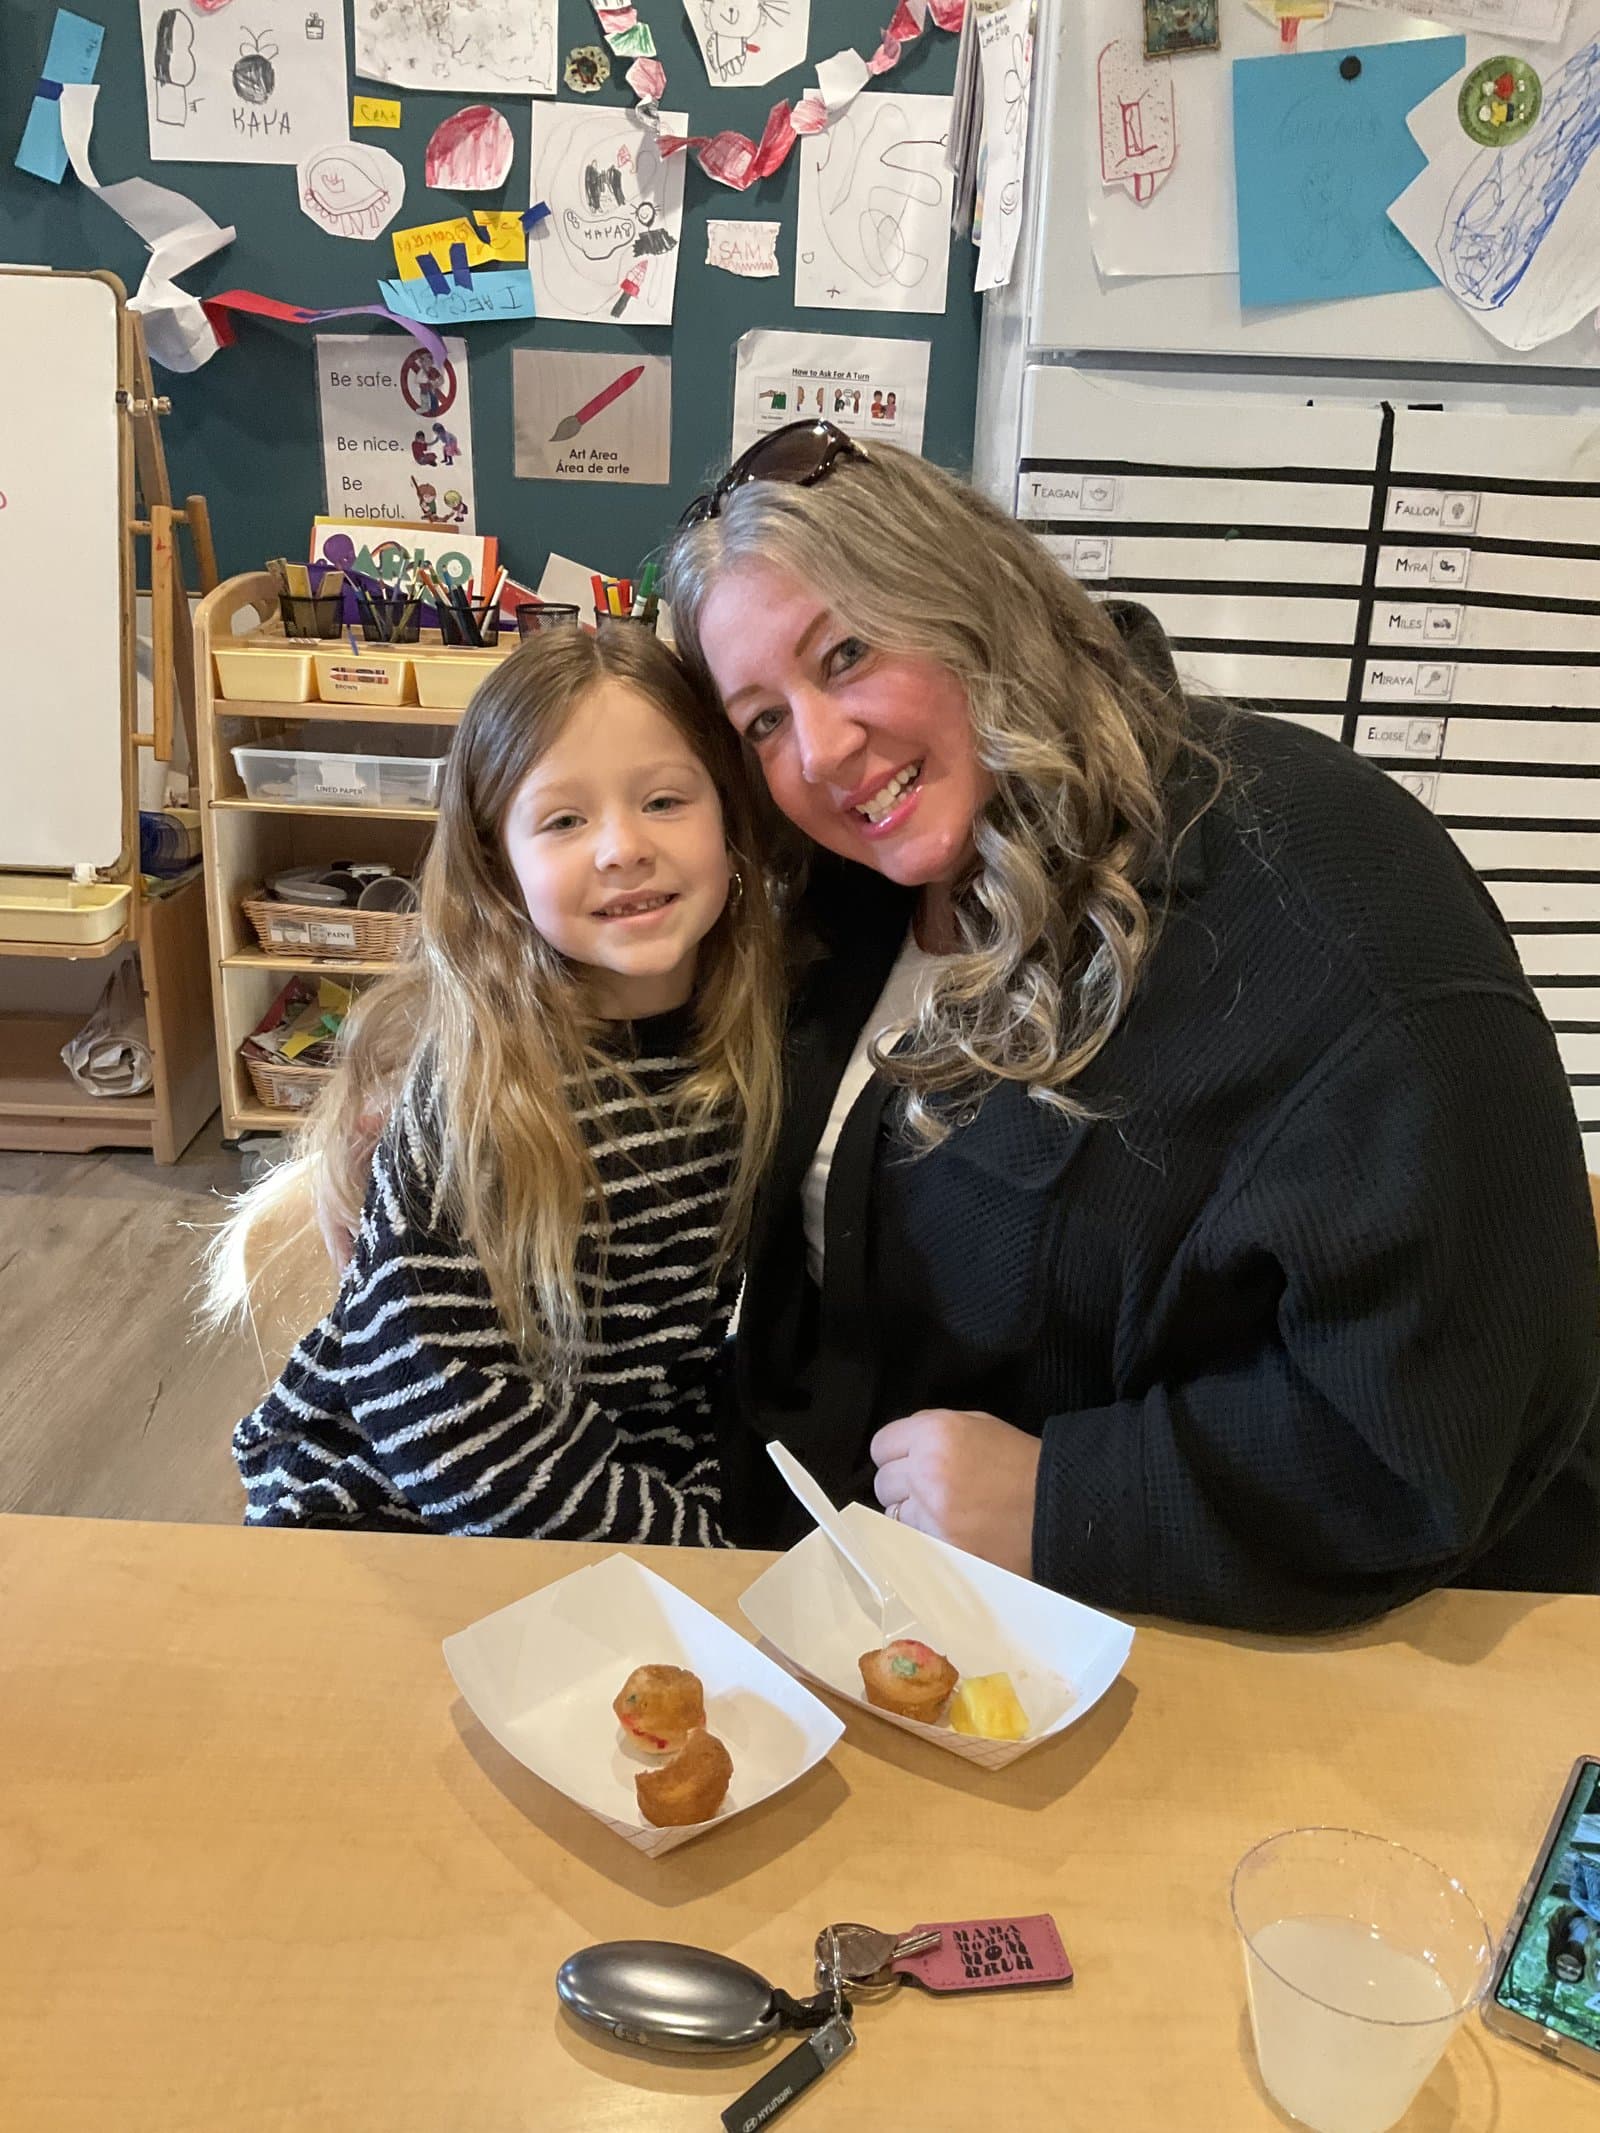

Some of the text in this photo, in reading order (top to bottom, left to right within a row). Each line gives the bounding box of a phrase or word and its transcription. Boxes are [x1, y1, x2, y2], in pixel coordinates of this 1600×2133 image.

[718, 240, 762, 260] SAM
[330, 371, 397, 388] Be safe.
[792, 368, 870, 381] How to Ask For A Turn
[337, 436, 404, 451] Be nice.
[569, 448, 618, 461] Art Area
[555, 459, 630, 474] Área de arte
[342, 476, 363, 491] Be
[1031, 483, 1080, 499] TEAGAN
[344, 504, 405, 520] helpful.
[1395, 501, 1440, 517] FALLON
[1395, 558, 1429, 572] MYRA
[1388, 614, 1422, 630] MILES
[1371, 671, 1414, 685] MIRAYA
[1367, 727, 1406, 742] ELOISE
[315, 785, 363, 795] LINED PAPER
[327, 931, 350, 939] PAINT
[965, 1955, 1035, 1979] BRUH
